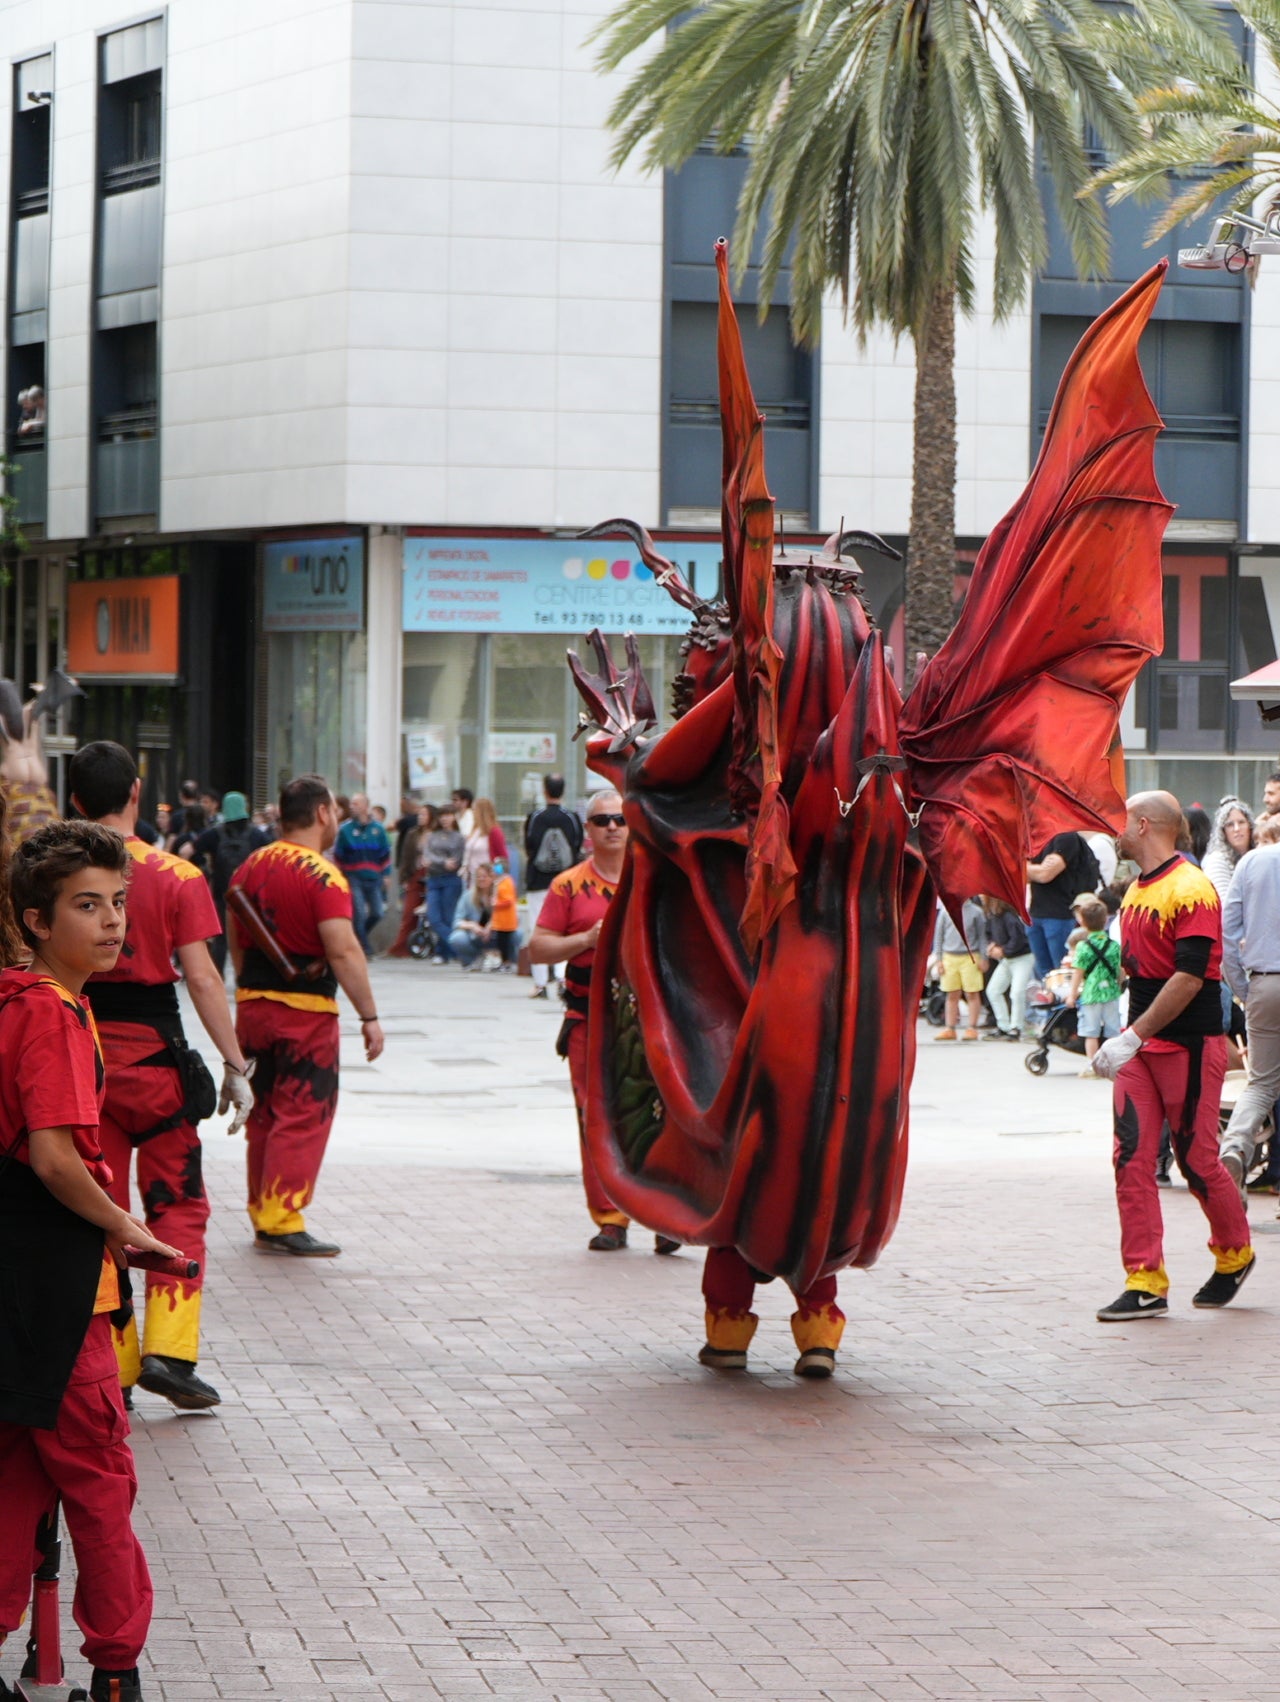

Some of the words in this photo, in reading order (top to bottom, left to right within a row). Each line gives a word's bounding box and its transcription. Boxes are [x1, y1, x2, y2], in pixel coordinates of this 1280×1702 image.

[534, 584, 608, 606] CENTRE
[561, 613, 578, 625] 93
[582, 613, 605, 626] 780
[610, 614, 624, 626] 13
[628, 614, 644, 626] 48
